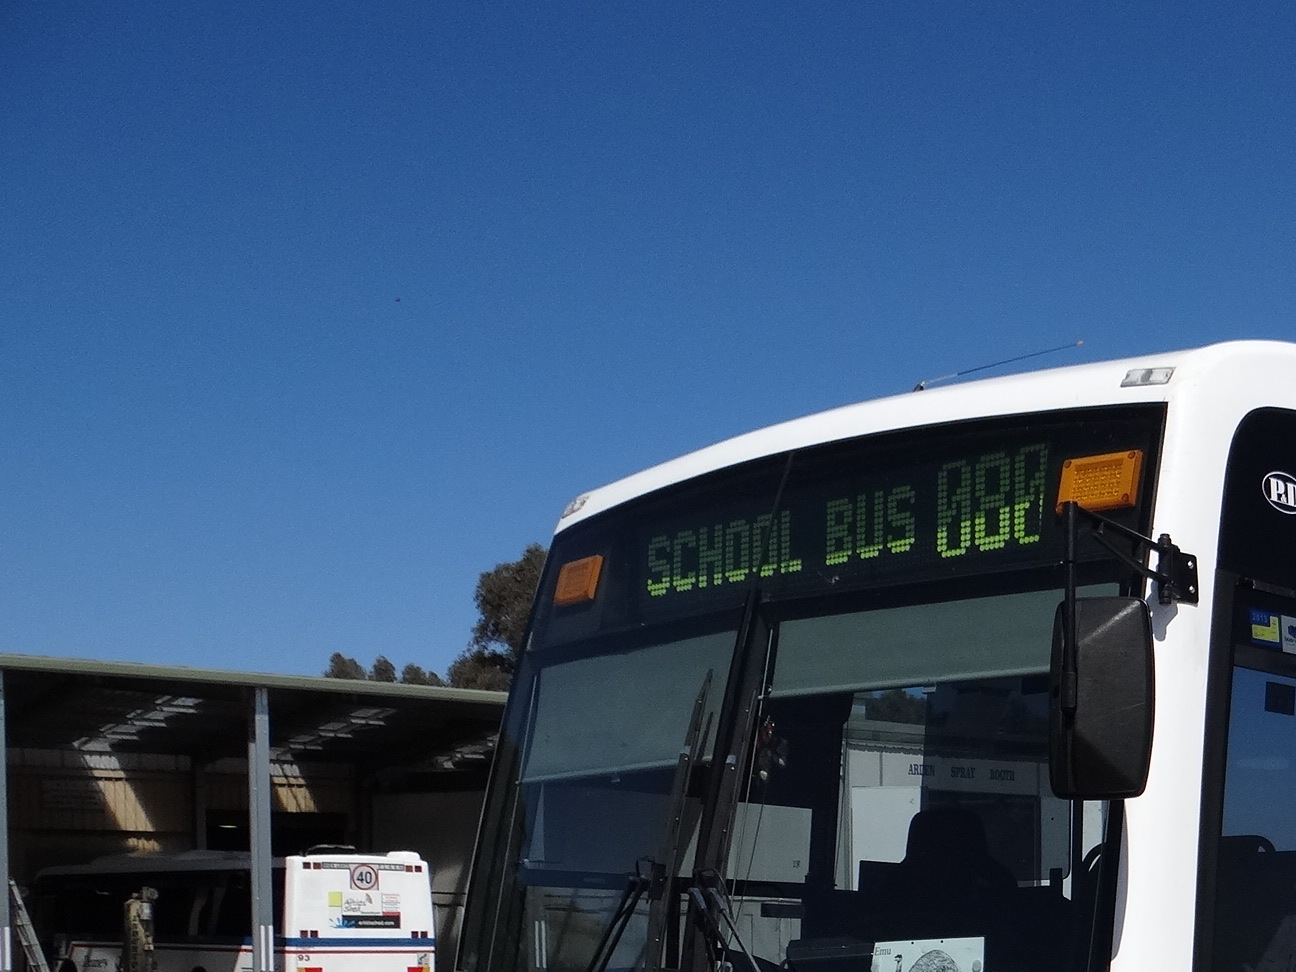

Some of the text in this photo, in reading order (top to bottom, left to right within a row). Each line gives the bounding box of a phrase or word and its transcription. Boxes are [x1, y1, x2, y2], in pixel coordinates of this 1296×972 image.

[648, 510, 802, 596] SCHOOL
[826, 486, 915, 566] BUS
[356, 871, 373, 885] 40
[874, 947, 892, 956] Emu
